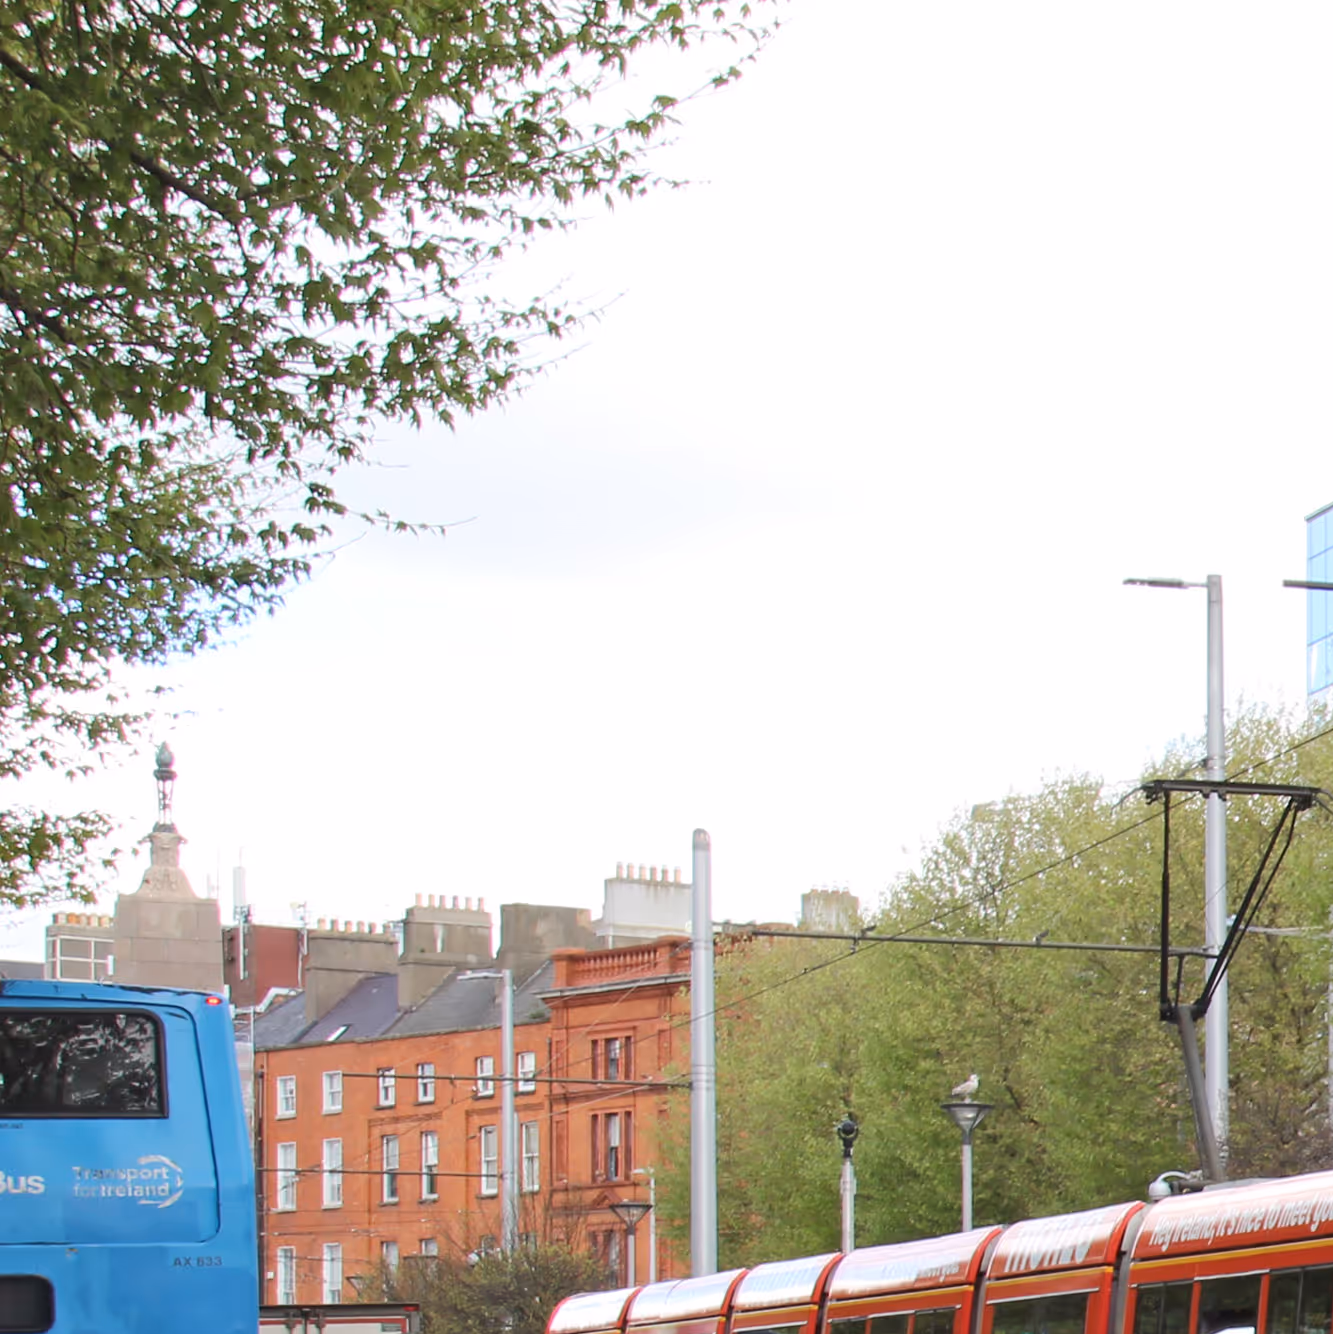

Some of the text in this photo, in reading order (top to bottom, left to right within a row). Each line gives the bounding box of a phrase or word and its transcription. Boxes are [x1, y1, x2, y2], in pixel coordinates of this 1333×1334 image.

[72, 1166, 169, 1182] Transport
[74, 1182, 169, 1197] for Ireland
[173, 1257, 192, 1267] AX
